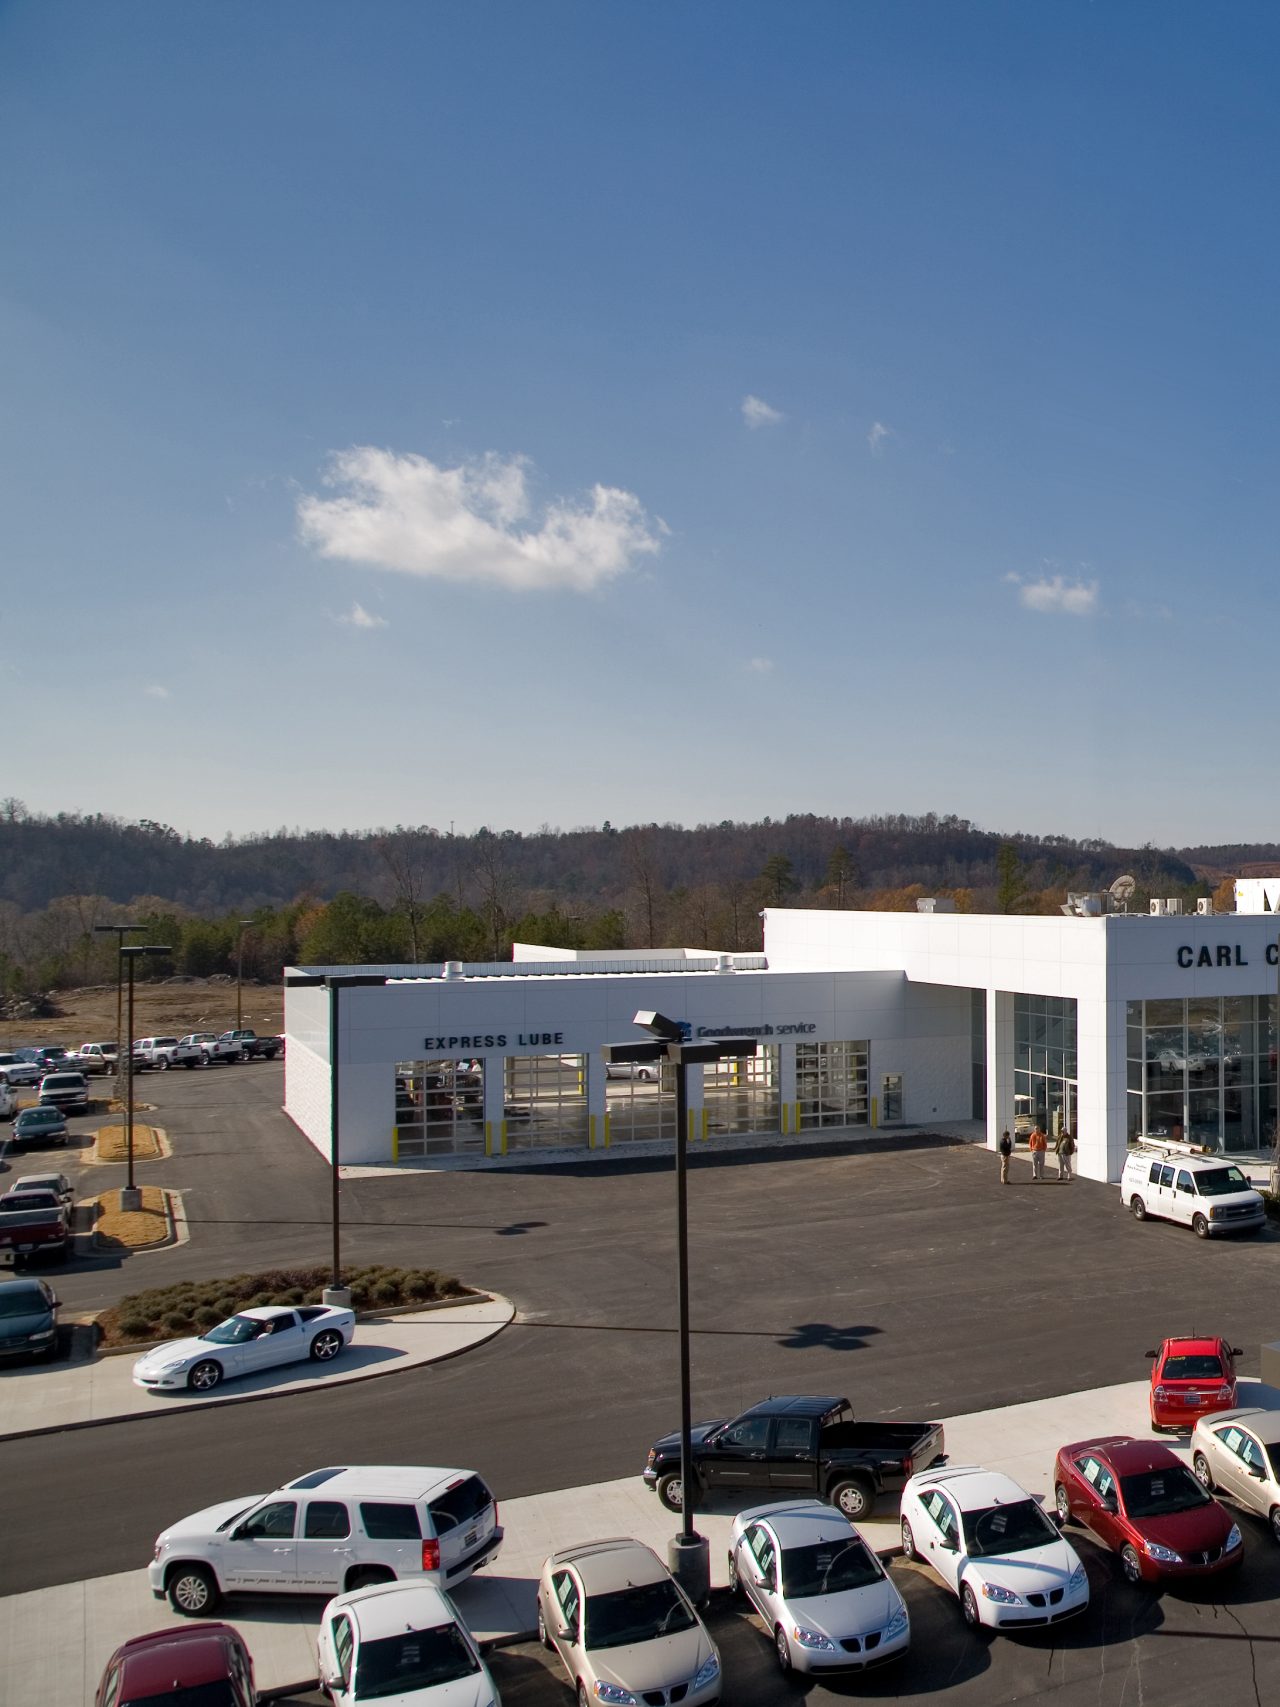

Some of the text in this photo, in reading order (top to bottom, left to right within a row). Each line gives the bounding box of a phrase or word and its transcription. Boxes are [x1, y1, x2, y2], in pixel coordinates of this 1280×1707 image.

[1177, 944, 1249, 969] CARL
[776, 1021, 817, 1036] service
[424, 1031, 565, 1051] EXPRESS LUBE
